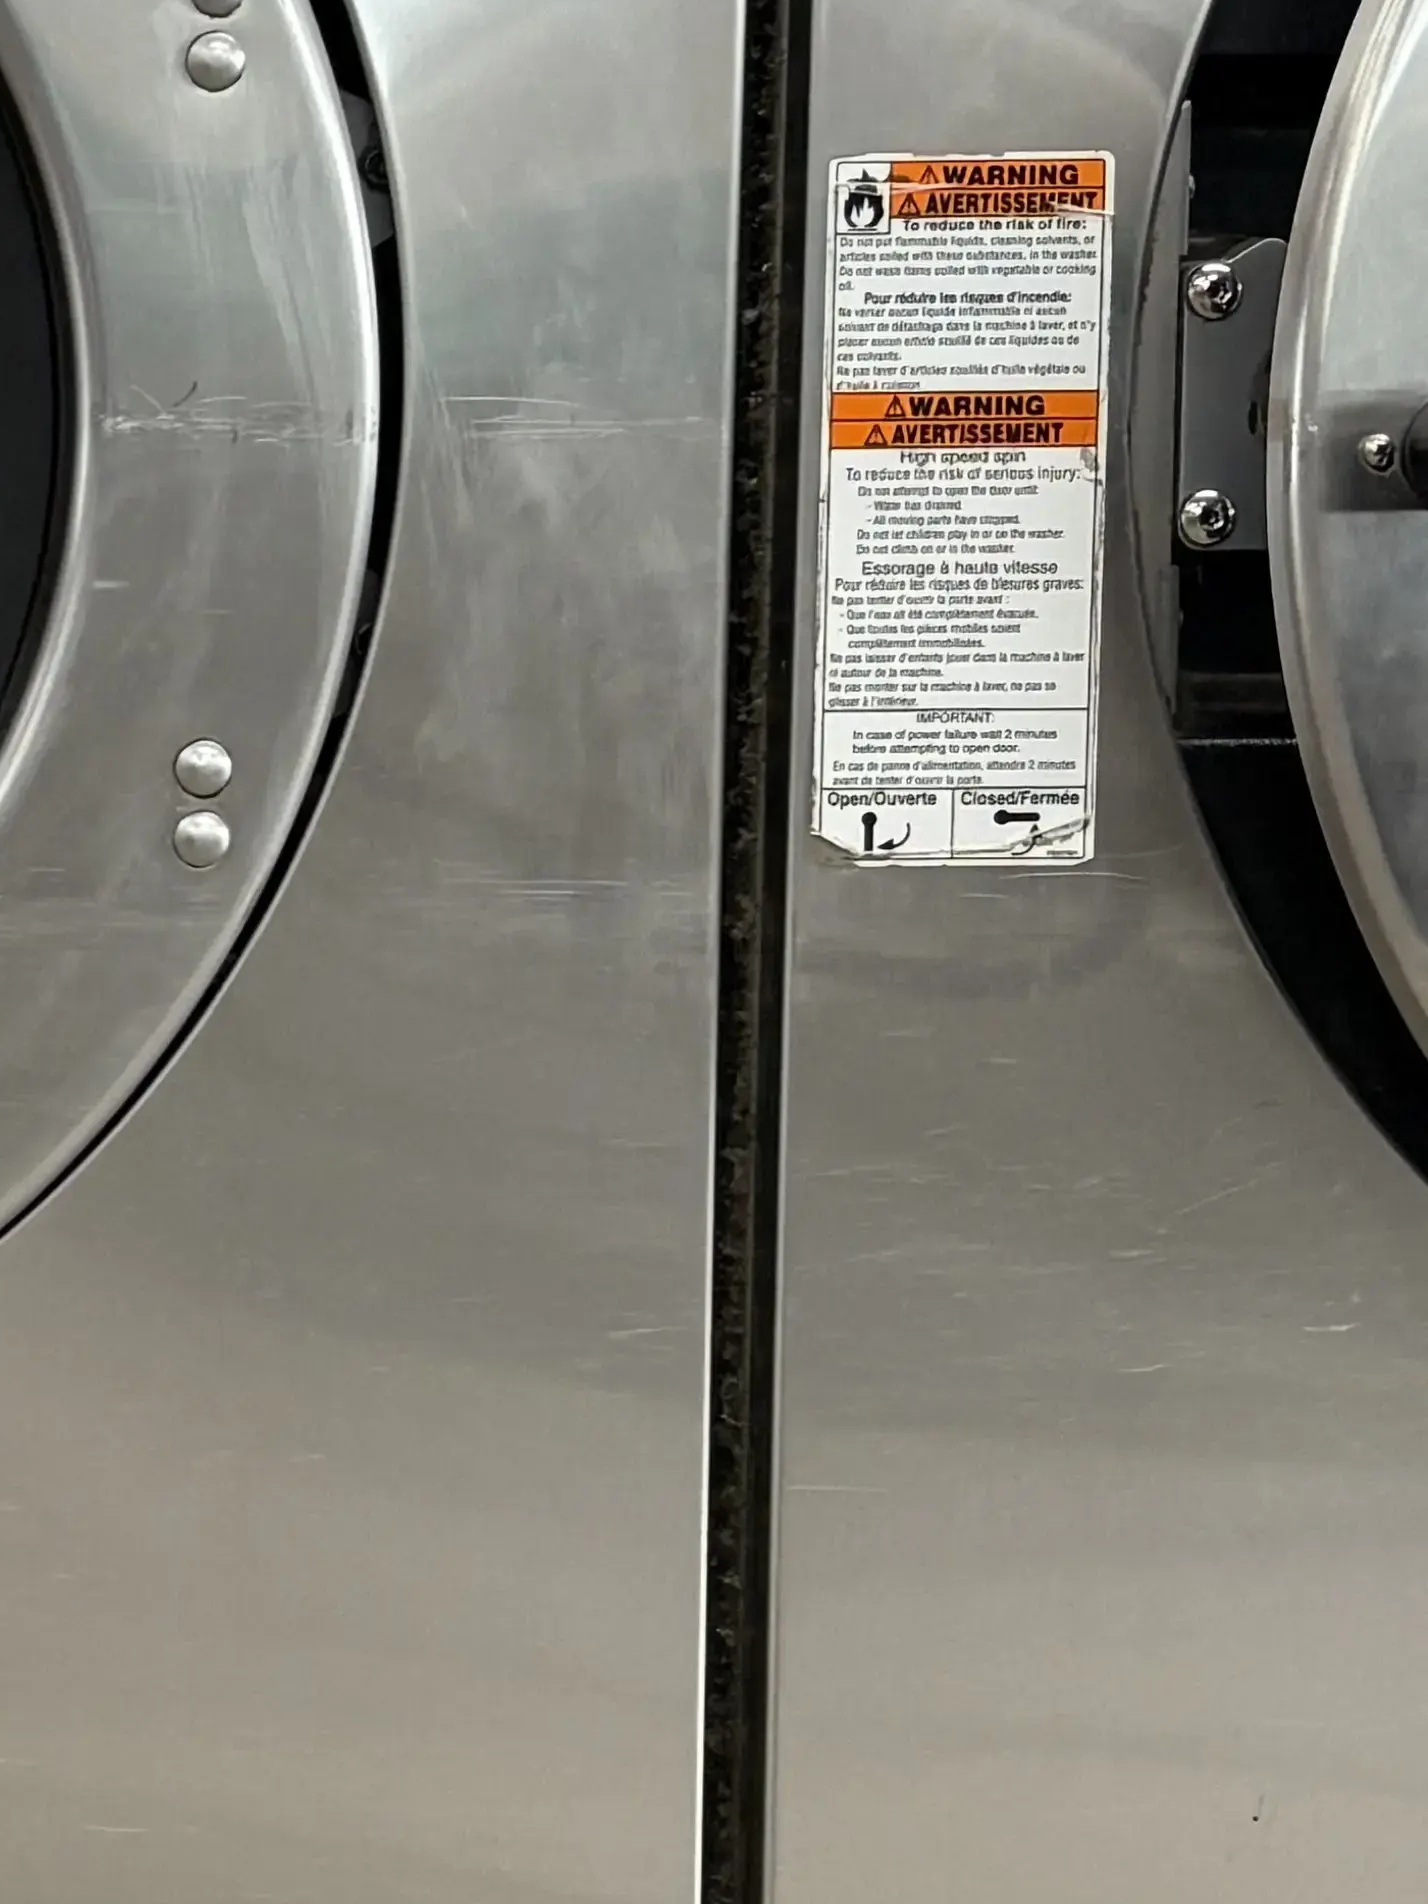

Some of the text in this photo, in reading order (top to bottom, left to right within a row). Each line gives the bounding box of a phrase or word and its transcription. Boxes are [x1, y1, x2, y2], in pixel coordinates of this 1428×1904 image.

[944, 165, 1079, 185] WARNING
[904, 219, 1086, 231] To reduce the risk of fire:
[865, 292, 891, 304] Pour
[910, 395, 1045, 416] WARNING
[892, 423, 1063, 443] AVERTISSEMENT
[901, 452, 936, 466] High
[846, 468, 862, 481] To
[914, 468, 935, 480] the
[968, 468, 982, 480] of
[1037, 466, 1080, 482] injury:
[862, 562, 935, 577] Essorage
[955, 562, 998, 574] haute
[1003, 562, 1058, 574] vitesse
[835, 579, 862, 591] Pour
[974, 578, 987, 590] de
[895, 730, 906, 740] of
[949, 744, 959, 753] to
[963, 745, 990, 755] open
[828, 792, 937, 809] Open/Ouverte
[961, 790, 1080, 805] Closed/Fermée
